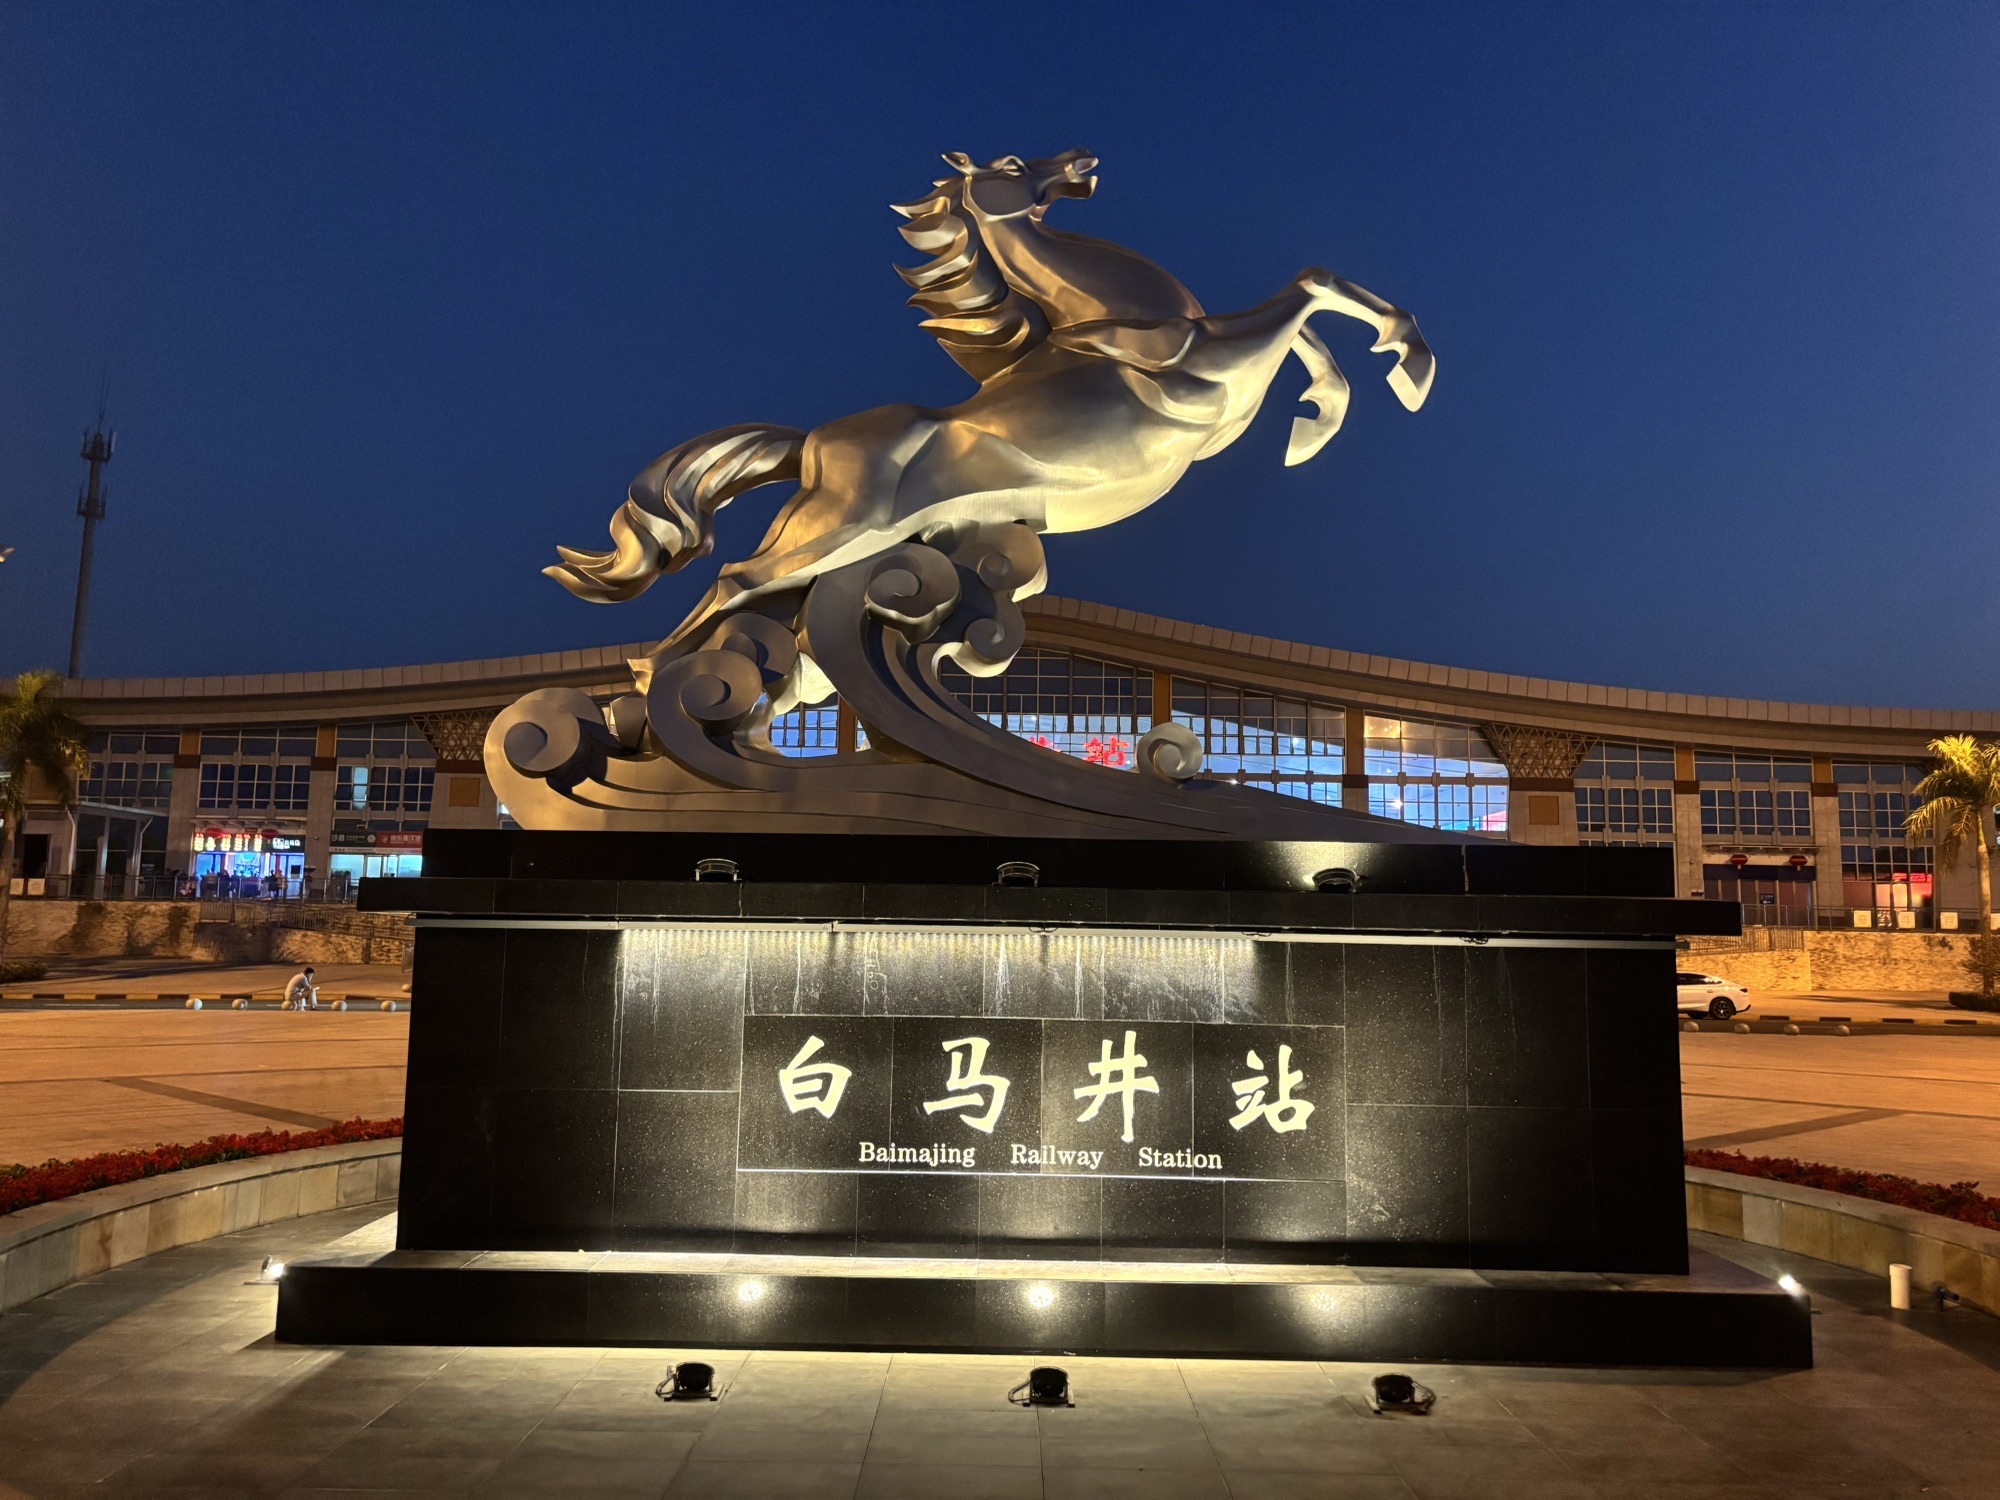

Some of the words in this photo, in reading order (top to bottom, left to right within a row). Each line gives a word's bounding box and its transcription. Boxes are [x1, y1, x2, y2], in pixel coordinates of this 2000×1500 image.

[778, 1030, 1316, 1142] 白马井站
[858, 1141, 976, 1168] Baimajing
[1010, 1143, 1104, 1168] Railway
[1138, 1146, 1223, 1169] Station
